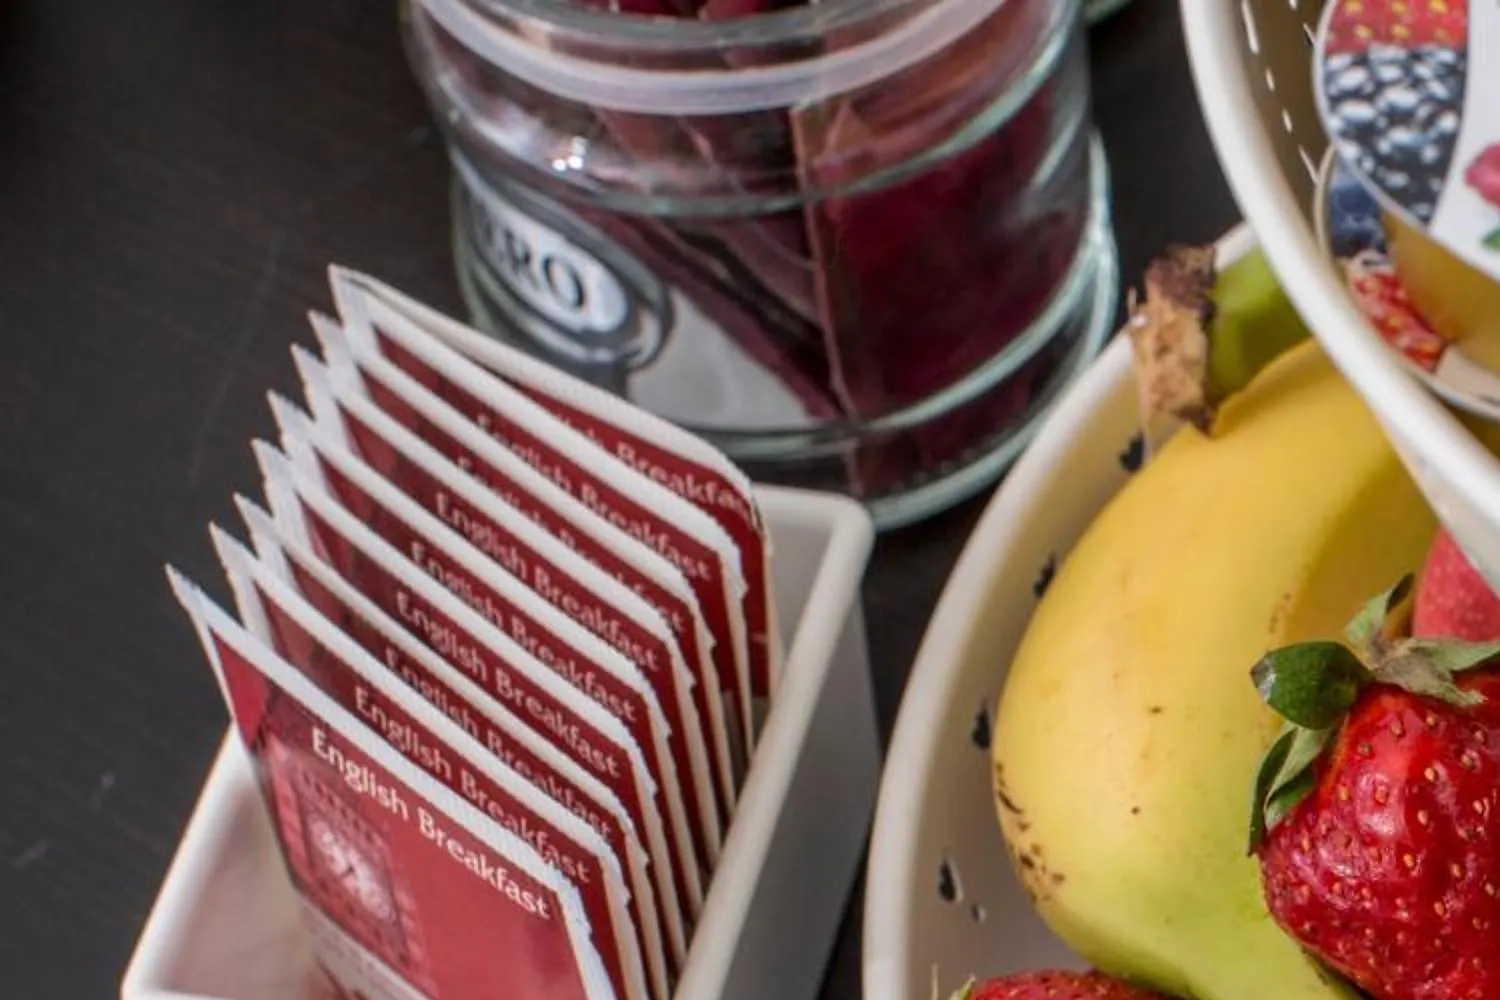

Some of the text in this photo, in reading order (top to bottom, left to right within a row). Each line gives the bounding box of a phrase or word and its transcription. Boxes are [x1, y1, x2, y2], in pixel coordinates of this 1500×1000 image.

[436, 492, 527, 579] English
[534, 565, 660, 672] Breakfast
[511, 615, 637, 722] Breakfast
[396, 590, 621, 778] English Breakfast
[311, 726, 552, 921] English Breakfast
[354, 685, 592, 884] English Breakfast
